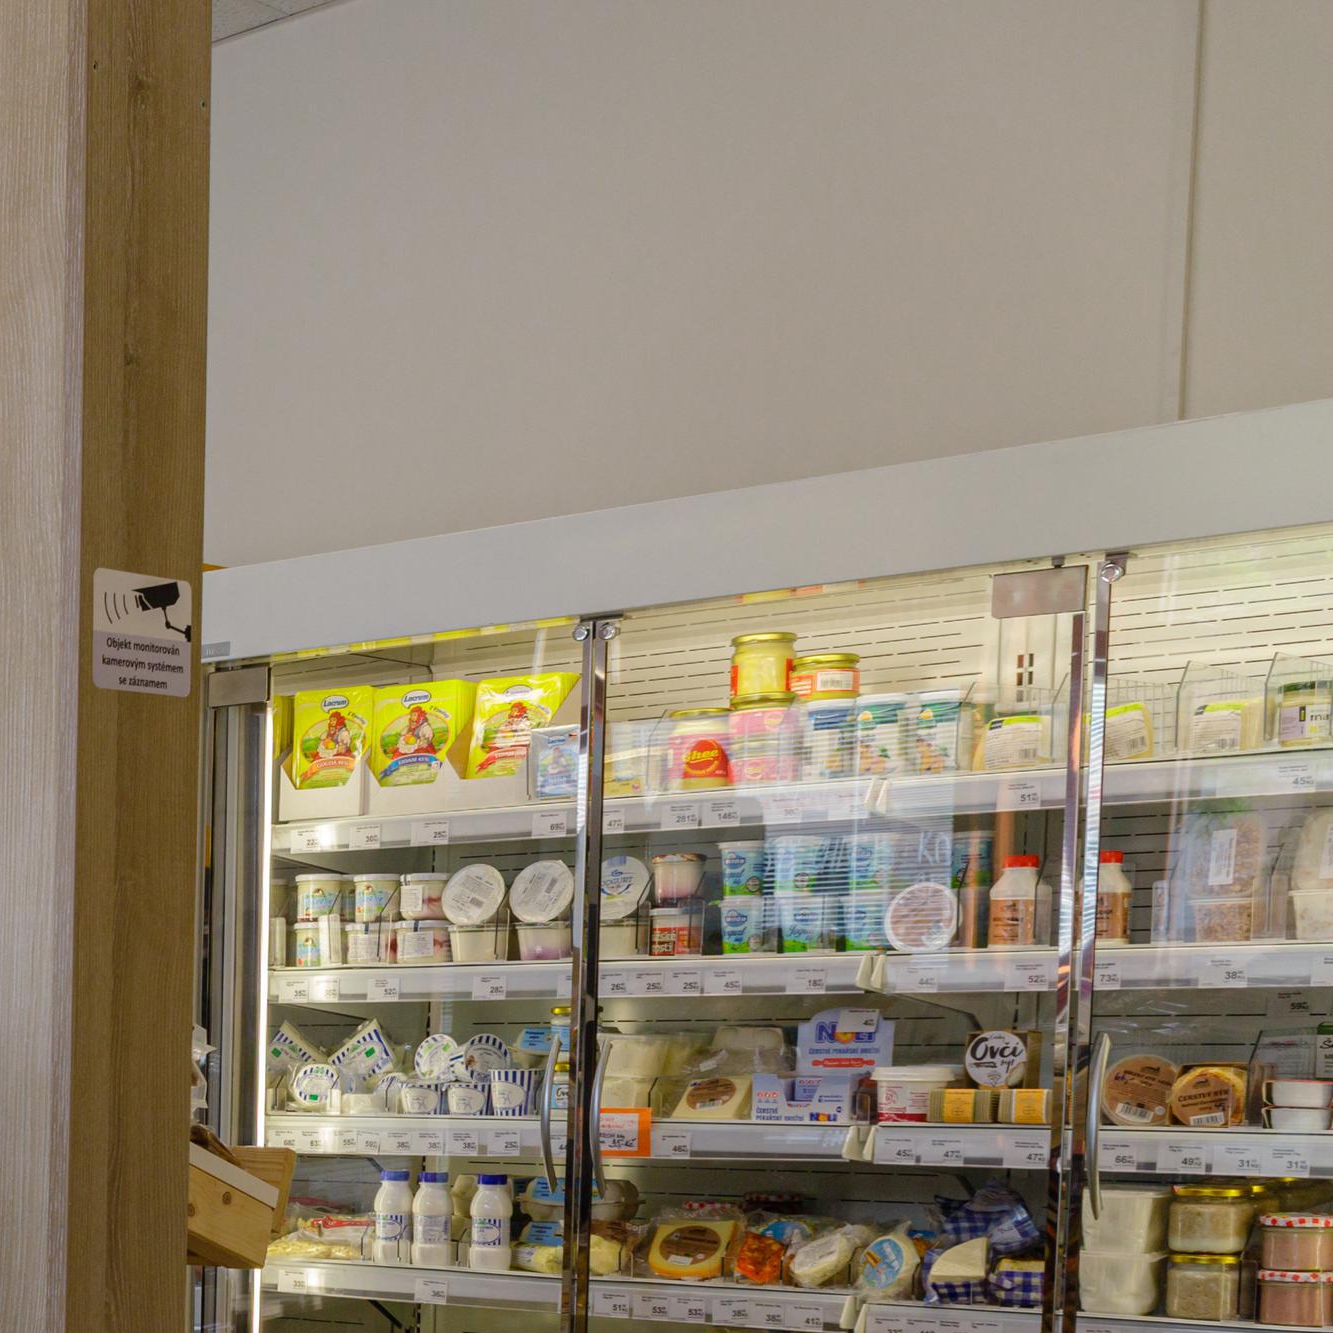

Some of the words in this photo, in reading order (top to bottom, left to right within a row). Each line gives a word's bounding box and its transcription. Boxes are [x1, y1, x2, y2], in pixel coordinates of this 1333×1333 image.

[106, 637, 132, 651] Objekt
[133, 642, 180, 656] monitorován
[102, 654, 146, 670] kamerovým
[147, 661, 184, 674] systémem
[118, 677, 127, 685] se
[128, 677, 168, 689] záznamem
[322, 697, 348, 709] Lacrum
[403, 693, 430, 704] Lacrum
[682, 747, 719, 763] Ghee
[970, 1035, 1024, 1061] Ovčí
